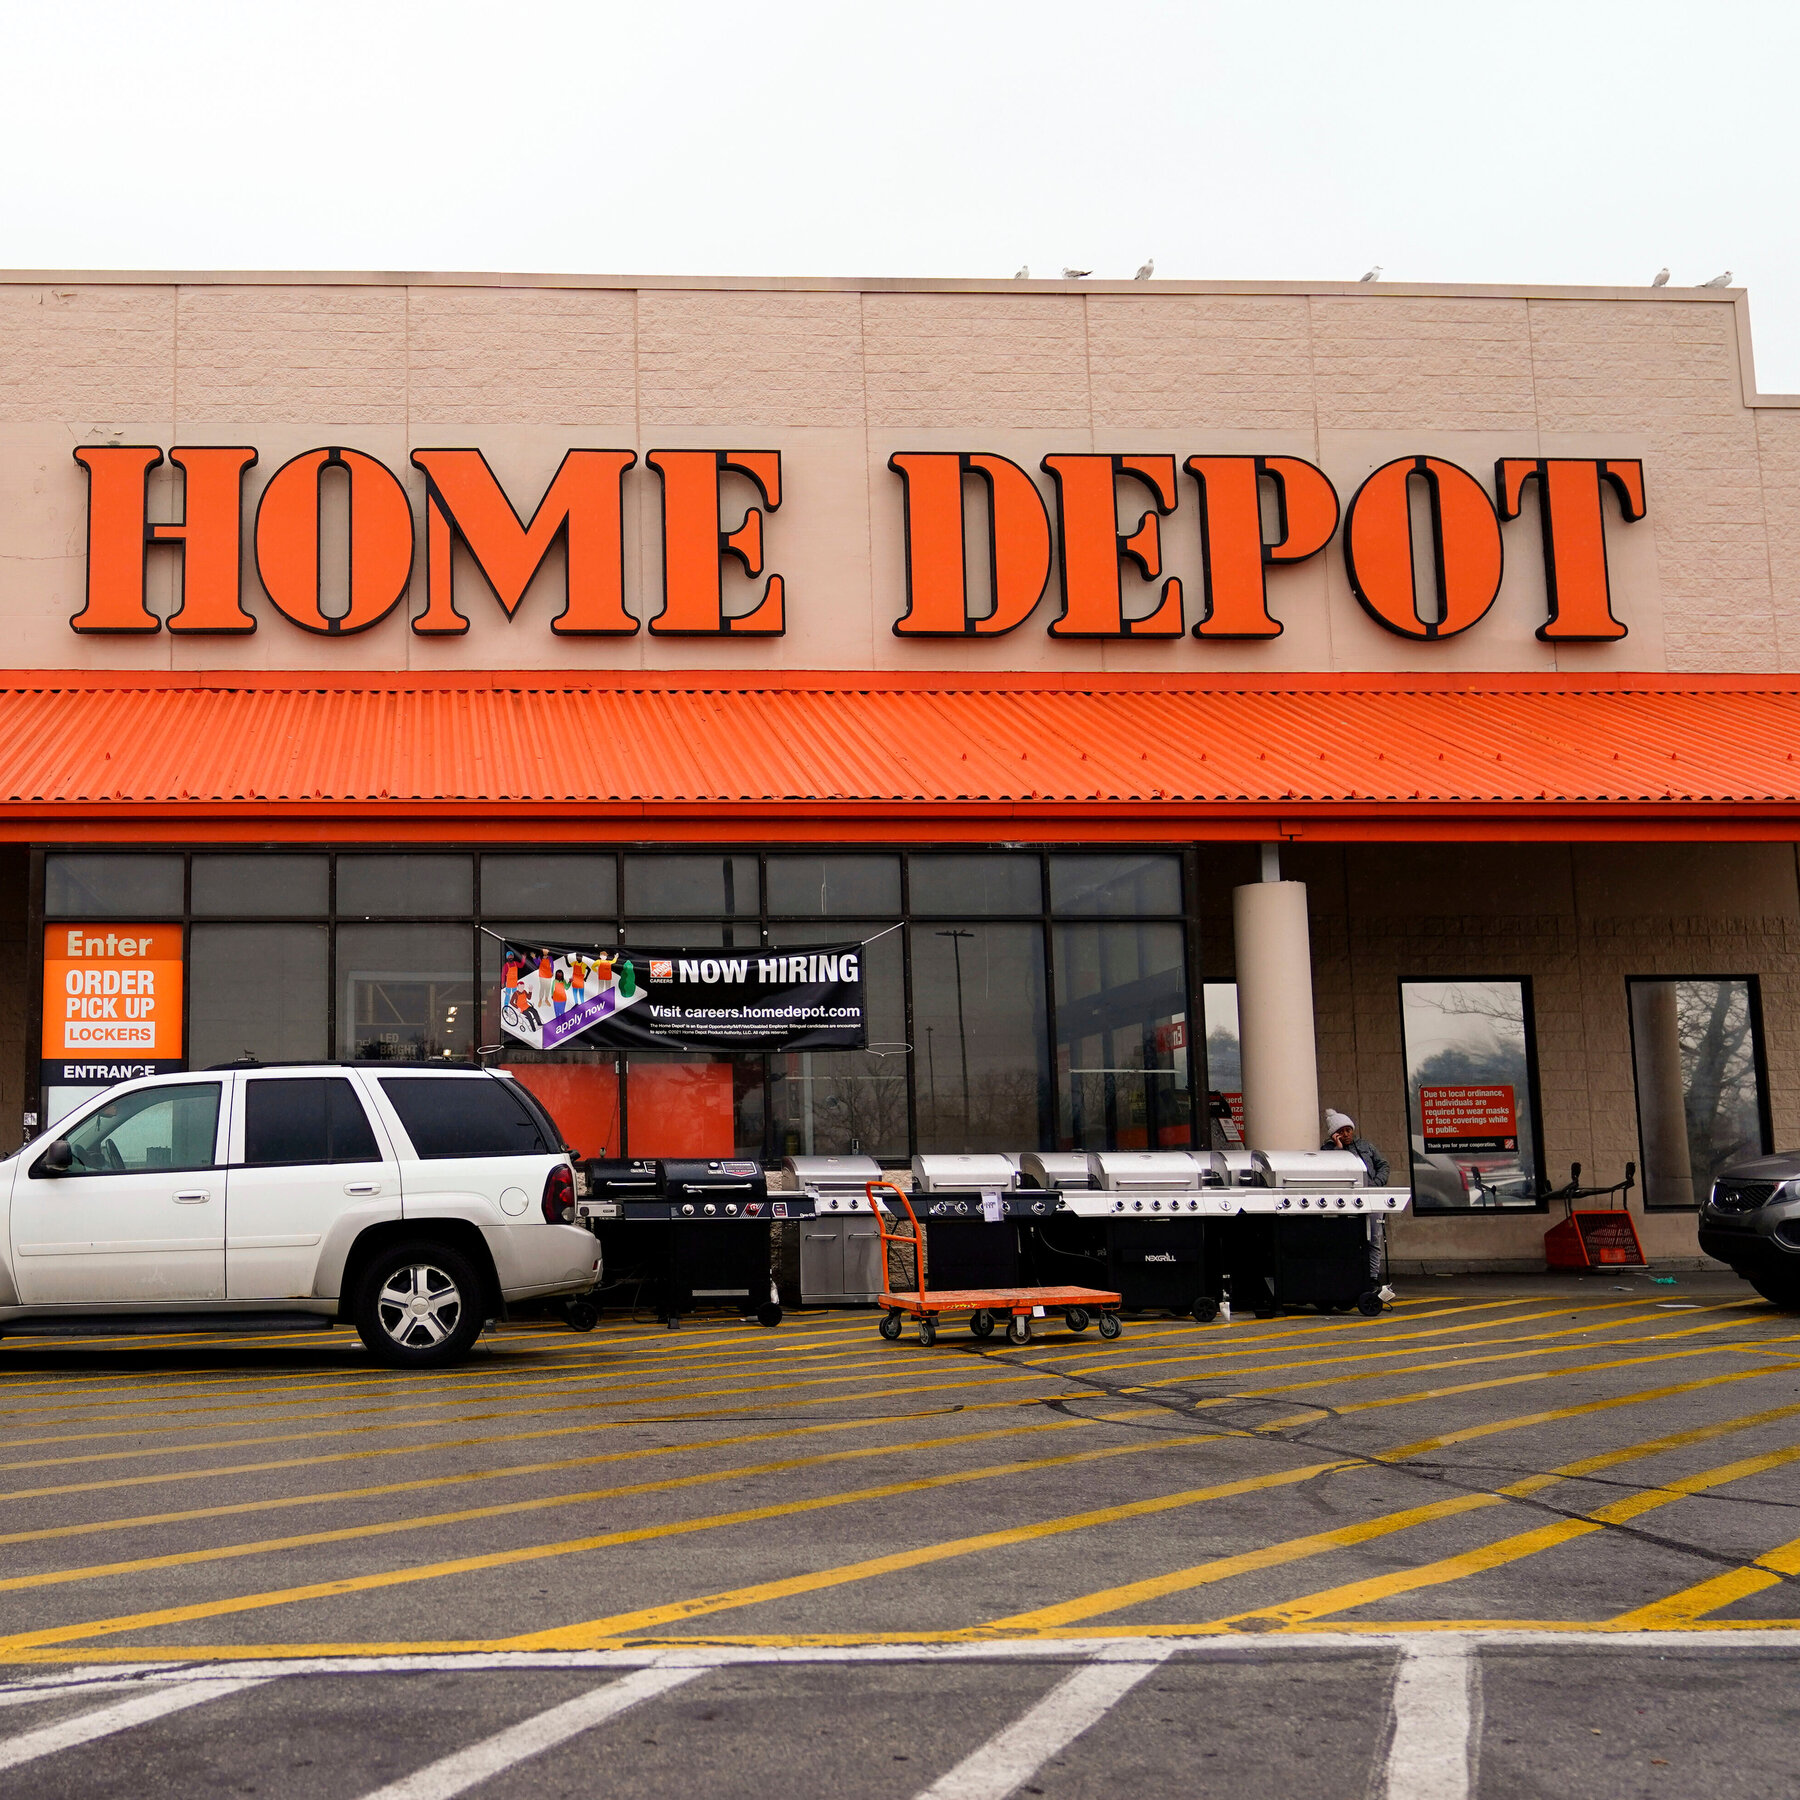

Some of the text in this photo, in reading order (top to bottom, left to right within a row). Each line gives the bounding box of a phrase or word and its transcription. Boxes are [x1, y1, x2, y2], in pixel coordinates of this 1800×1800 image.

[70, 445, 1647, 643] HOME DEPOT
[67, 930, 153, 957] Enter
[678, 953, 859, 984] NOW HIRING
[65, 969, 155, 995] ORDER
[66, 997, 155, 1019] PICK UP
[649, 1005, 860, 1020] Visit careers.homedepot.com
[555, 1000, 606, 1035] apply now
[69, 1027, 151, 1041] LOCKERS
[380, 1032, 399, 1043] LED
[380, 1044, 418, 1055] BRIGHT
[63, 1064, 156, 1079] ENTRANCE
[1424, 1089, 1505, 1098] Due to local ordinance,
[1424, 1099, 1434, 1107] all
[1435, 1098, 1474, 1107] individuals
[1425, 1107, 1455, 1116] required
[1456, 1107, 1465, 1115] to
[1485, 1106, 1510, 1115] masks
[1452, 1116, 1487, 1125] coverings
[1488, 1115, 1509, 1123] while
[1435, 1125, 1460, 1135] public.
[1145, 1251, 1177, 1262] NEXGRILL
